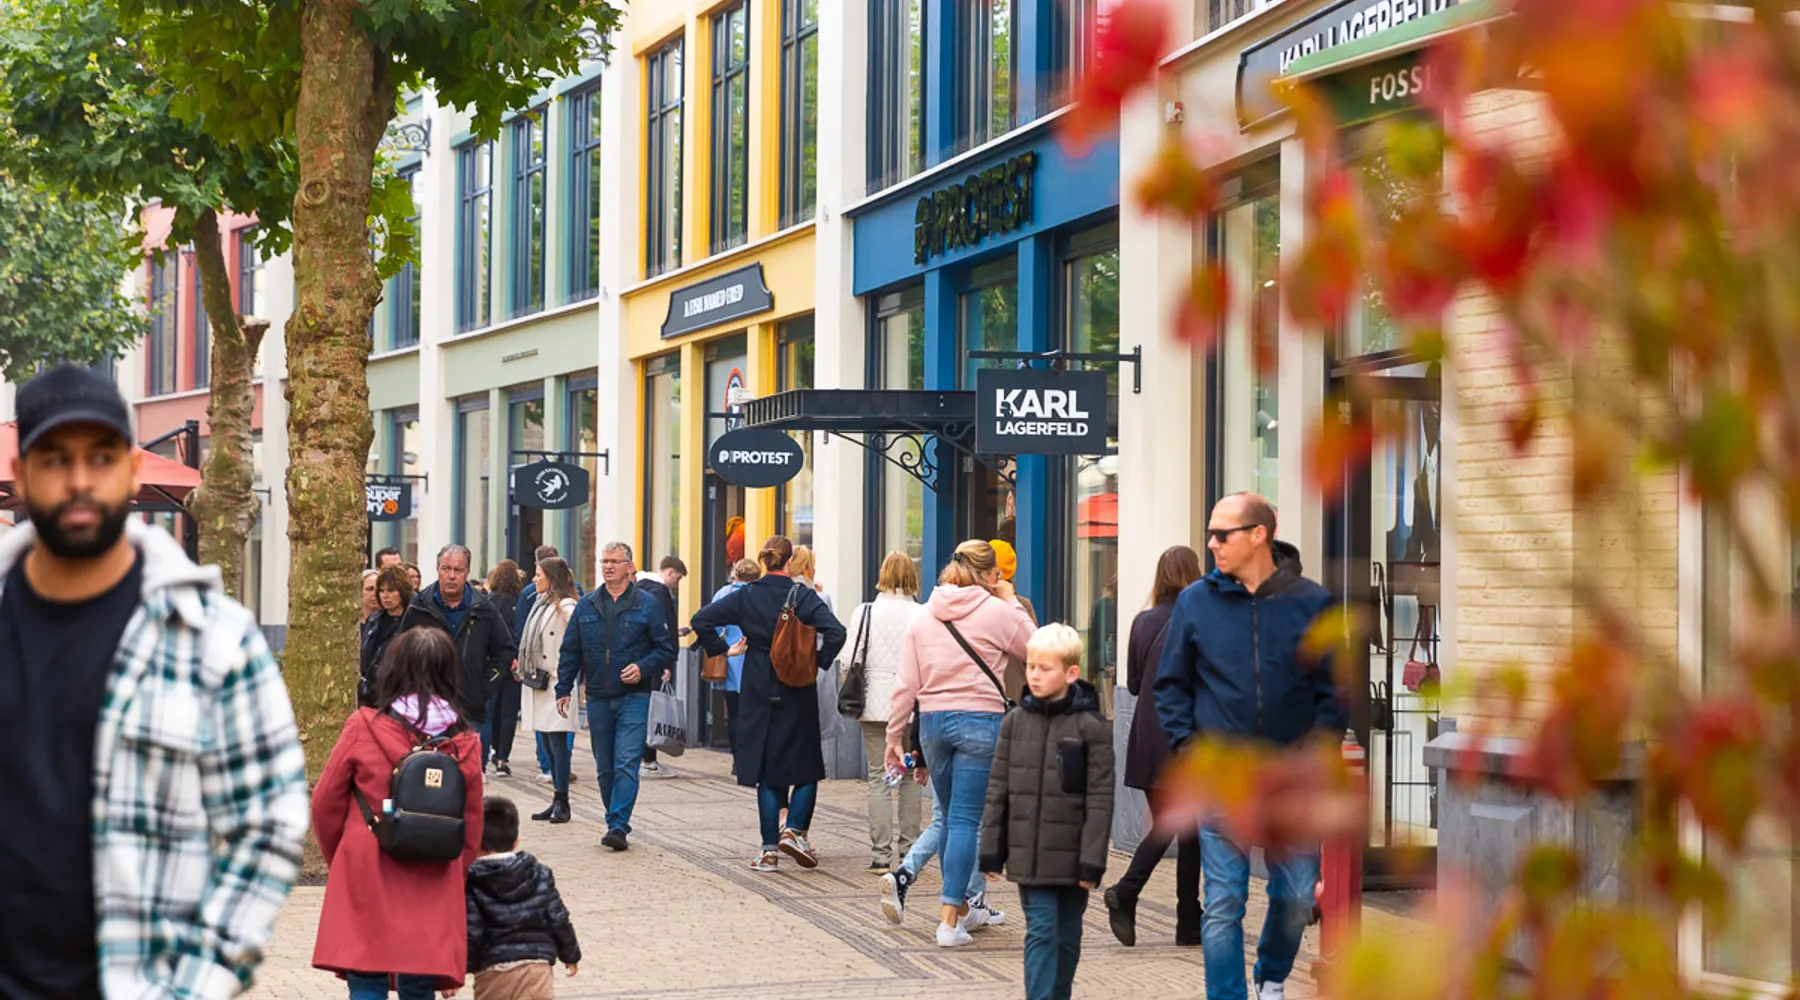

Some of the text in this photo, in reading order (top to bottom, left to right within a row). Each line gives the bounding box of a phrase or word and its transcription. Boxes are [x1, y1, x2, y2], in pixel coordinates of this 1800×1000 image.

[1327, 0, 1448, 49] LAGERFE
[1369, 64, 1432, 104] FOSSI
[996, 388, 1089, 419] KARL
[996, 421, 1089, 436] LAGERFELD
[733, 450, 793, 465] PROTEST
